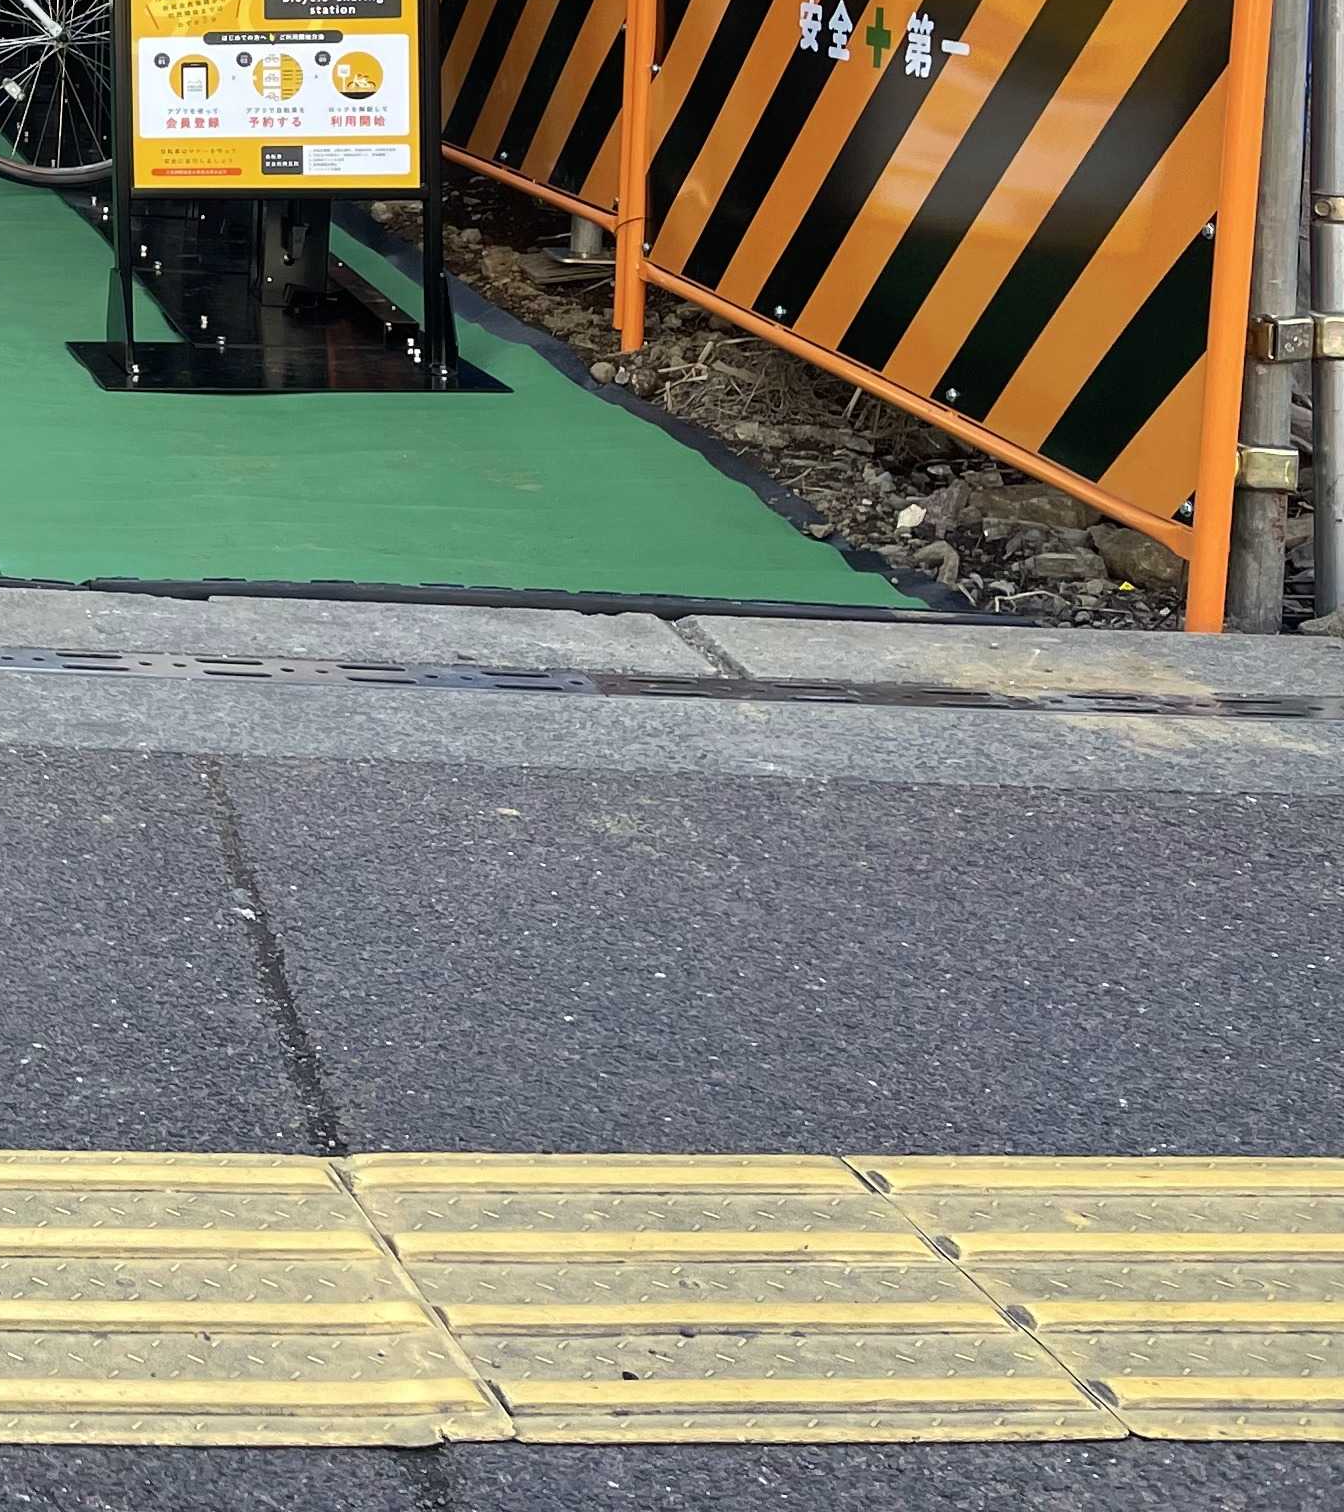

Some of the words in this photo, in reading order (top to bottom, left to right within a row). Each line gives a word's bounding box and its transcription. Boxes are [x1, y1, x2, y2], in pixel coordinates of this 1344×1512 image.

[310, 4, 356, 15] station
[166, 117, 219, 129] 会員登録
[249, 116, 301, 128] 予約する
[330, 115, 385, 127] 利用開始
